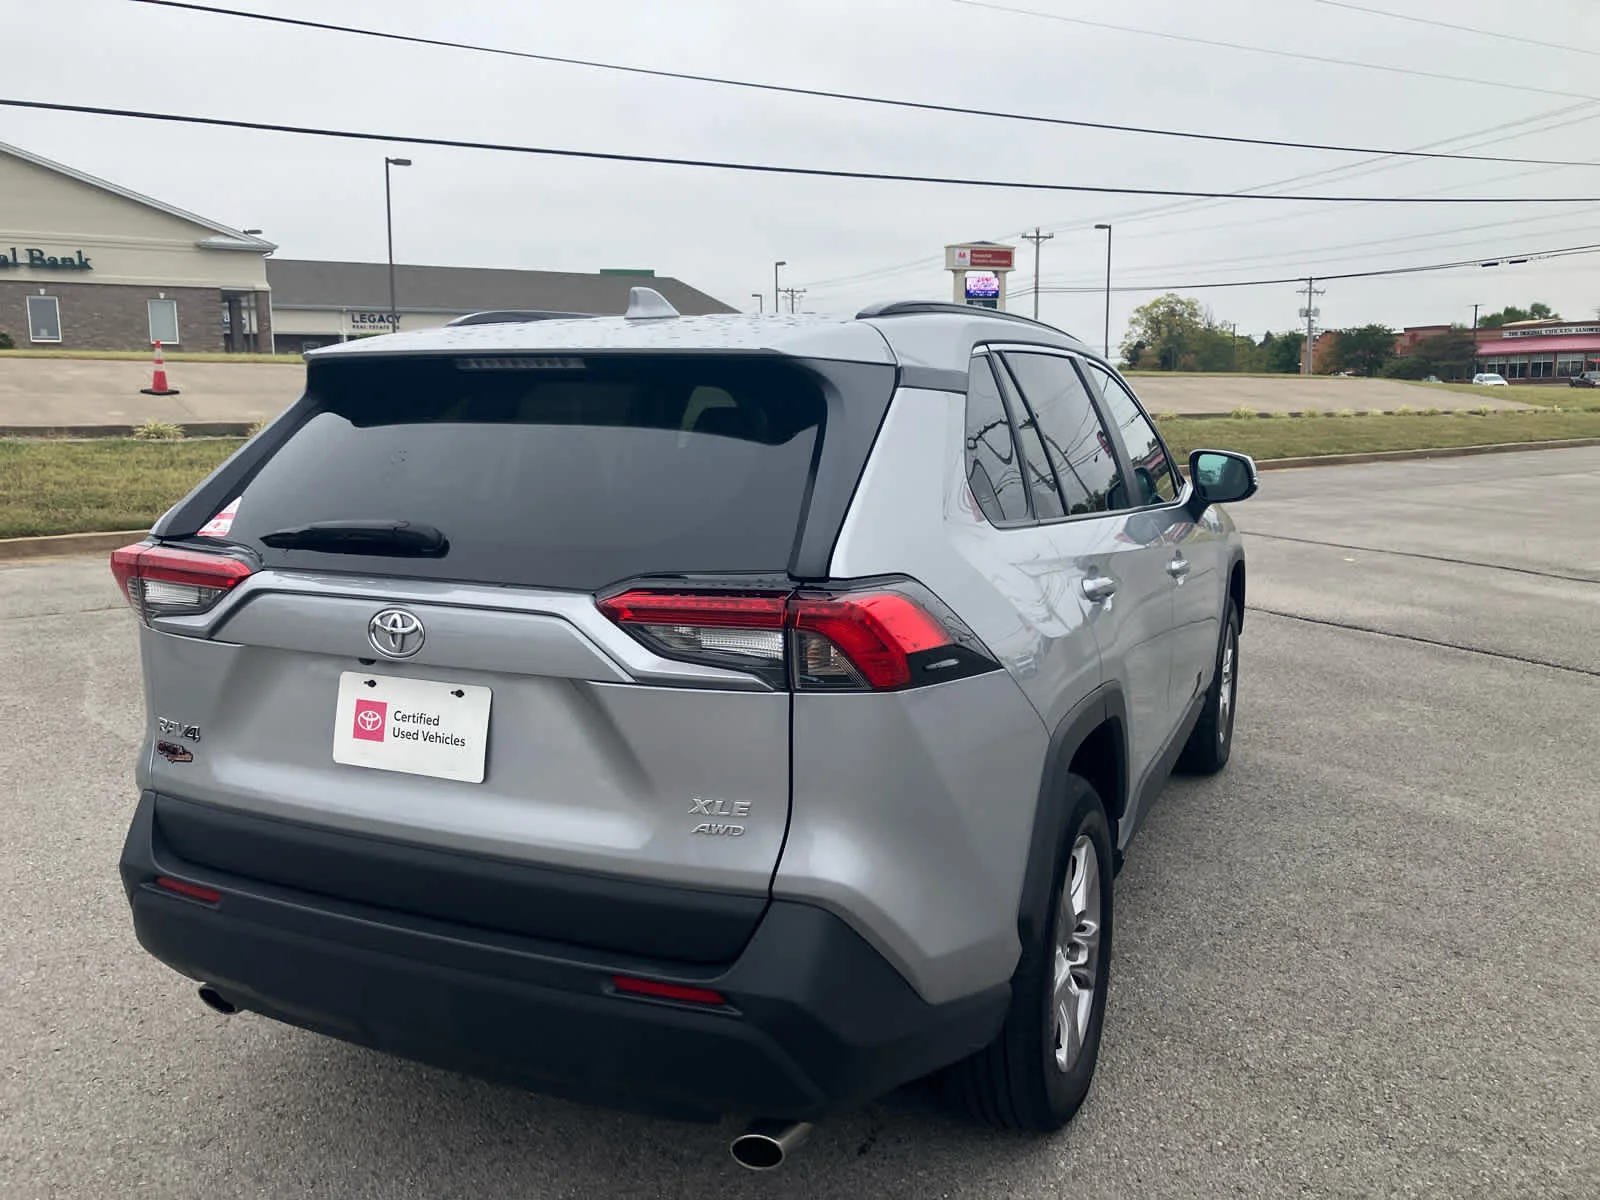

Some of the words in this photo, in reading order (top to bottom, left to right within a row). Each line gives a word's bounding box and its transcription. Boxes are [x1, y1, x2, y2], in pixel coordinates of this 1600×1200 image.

[25, 248, 93, 270] Bank
[351, 312, 401, 324] LEGACY
[393, 710, 440, 727] Certified
[158, 716, 201, 742] RAV4
[392, 727, 419, 741] Used
[421, 730, 466, 747] Vehicles
[688, 798, 752, 817] XLE
[691, 823, 745, 837] AWD
